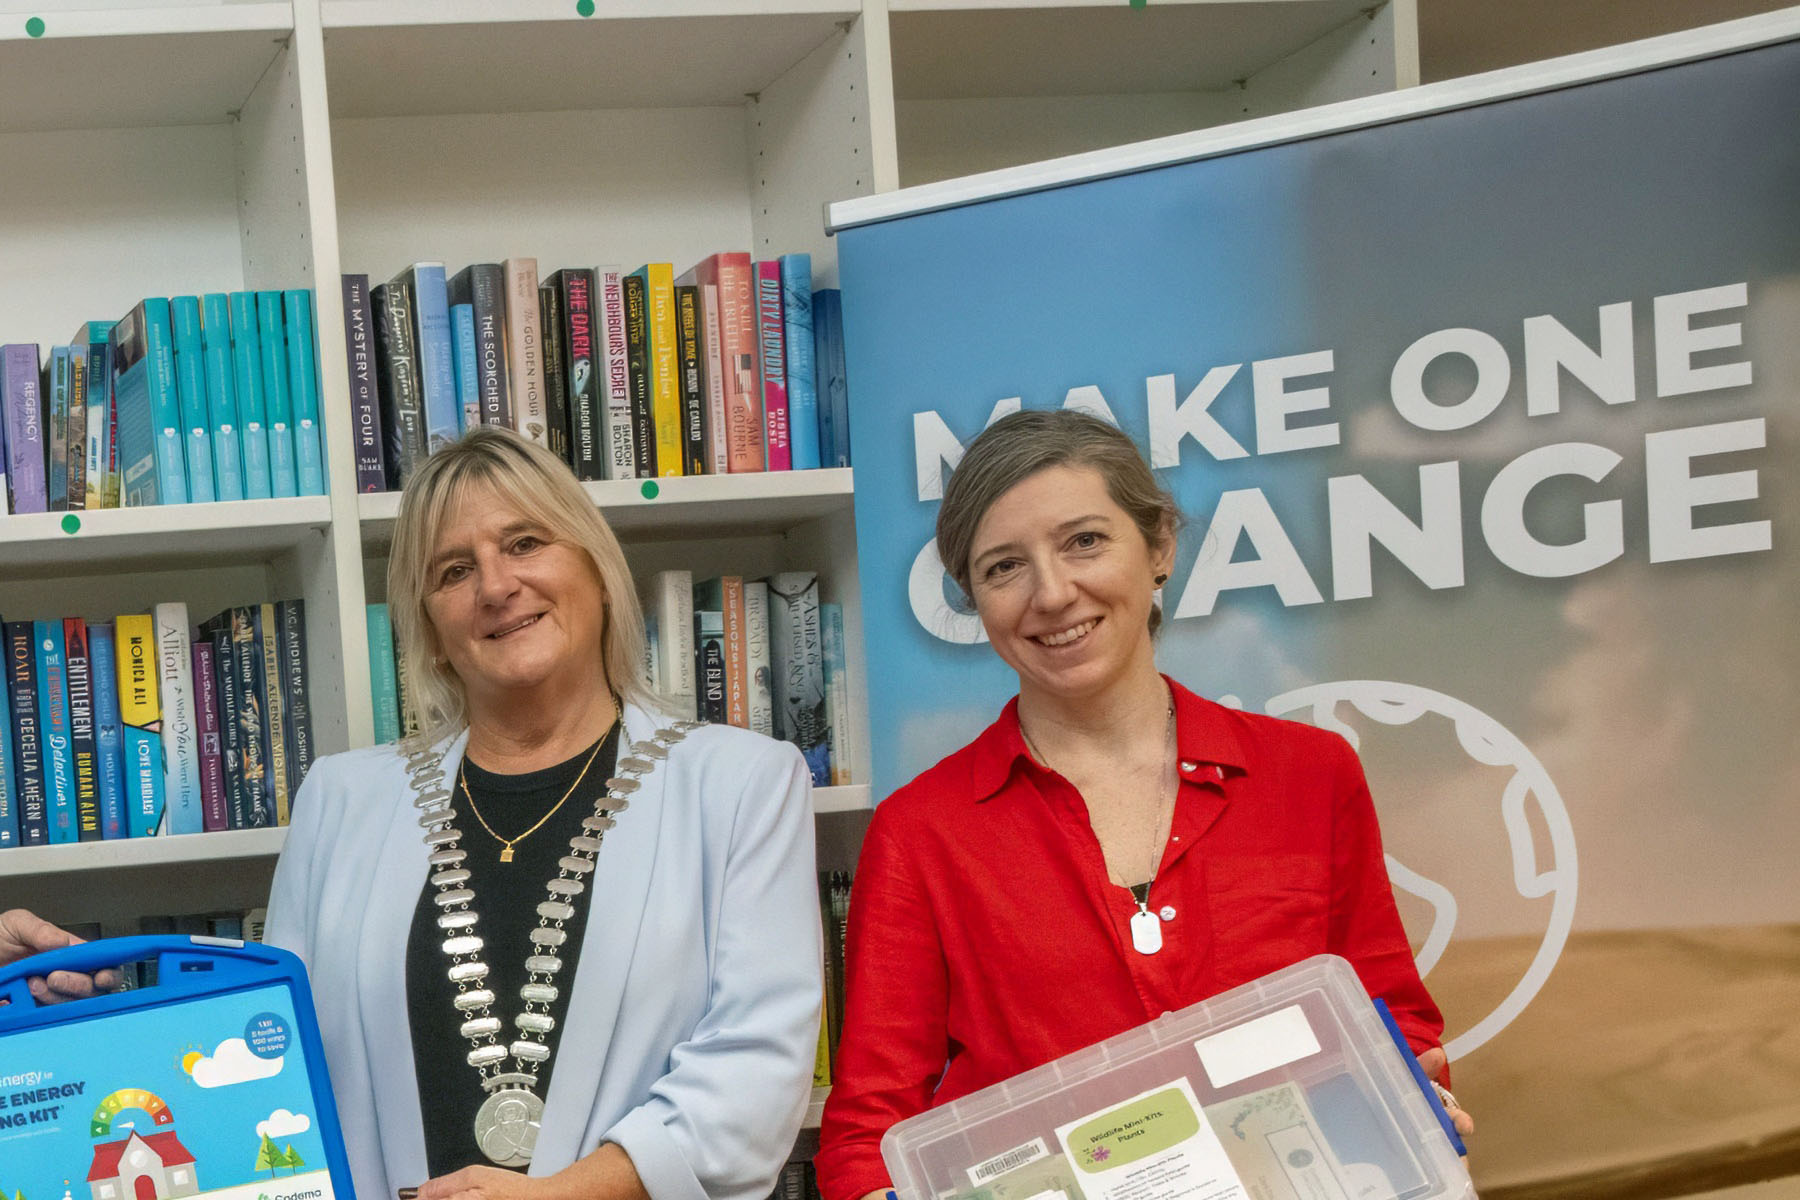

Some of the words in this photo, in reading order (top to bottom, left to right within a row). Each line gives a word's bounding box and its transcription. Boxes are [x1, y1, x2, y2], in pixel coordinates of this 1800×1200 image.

[569, 279, 587, 311] THE
[760, 279, 780, 320] DIRTY
[483, 316, 494, 338] THE
[571, 313, 591, 358] DARK
[606, 284, 625, 356] NEIGHBOUR'S
[725, 300, 739, 351] TRUTH
[352, 309, 369, 381] MYSTERY
[523, 326, 536, 376] GOLDEN
[763, 321, 783, 384] LAUNDRY
[1390, 281, 1754, 432] ONE
[484, 343, 499, 411] SCORCHED
[610, 358, 626, 401] SECRET
[24, 382, 38, 442] REGENCY
[360, 405, 374, 447] FOUR
[733, 406, 747, 459] BOURNE
[746, 419, 759, 447] SAM
[613, 425, 622, 466] BOLTON
[623, 424, 632, 466] SHARON
[908, 417, 1773, 646] CANGE
[14, 635, 29, 682] ROAR
[130, 637, 145, 682] MONICA
[161, 623, 179, 681] Alliott
[290, 631, 303, 695] ANDREWS
[68, 657, 92, 740] ENTITLEMENT
[134, 688, 146, 705] ALI
[20, 717, 36, 773] CECELIA
[137, 739, 152, 768] LOVE
[77, 752, 93, 799] RUMAAN
[24, 777, 40, 821] AHERN
[81, 801, 96, 832] ALAM
[10, 1081, 85, 1107] ENERGY
[30, 1106, 60, 1124] KIT
